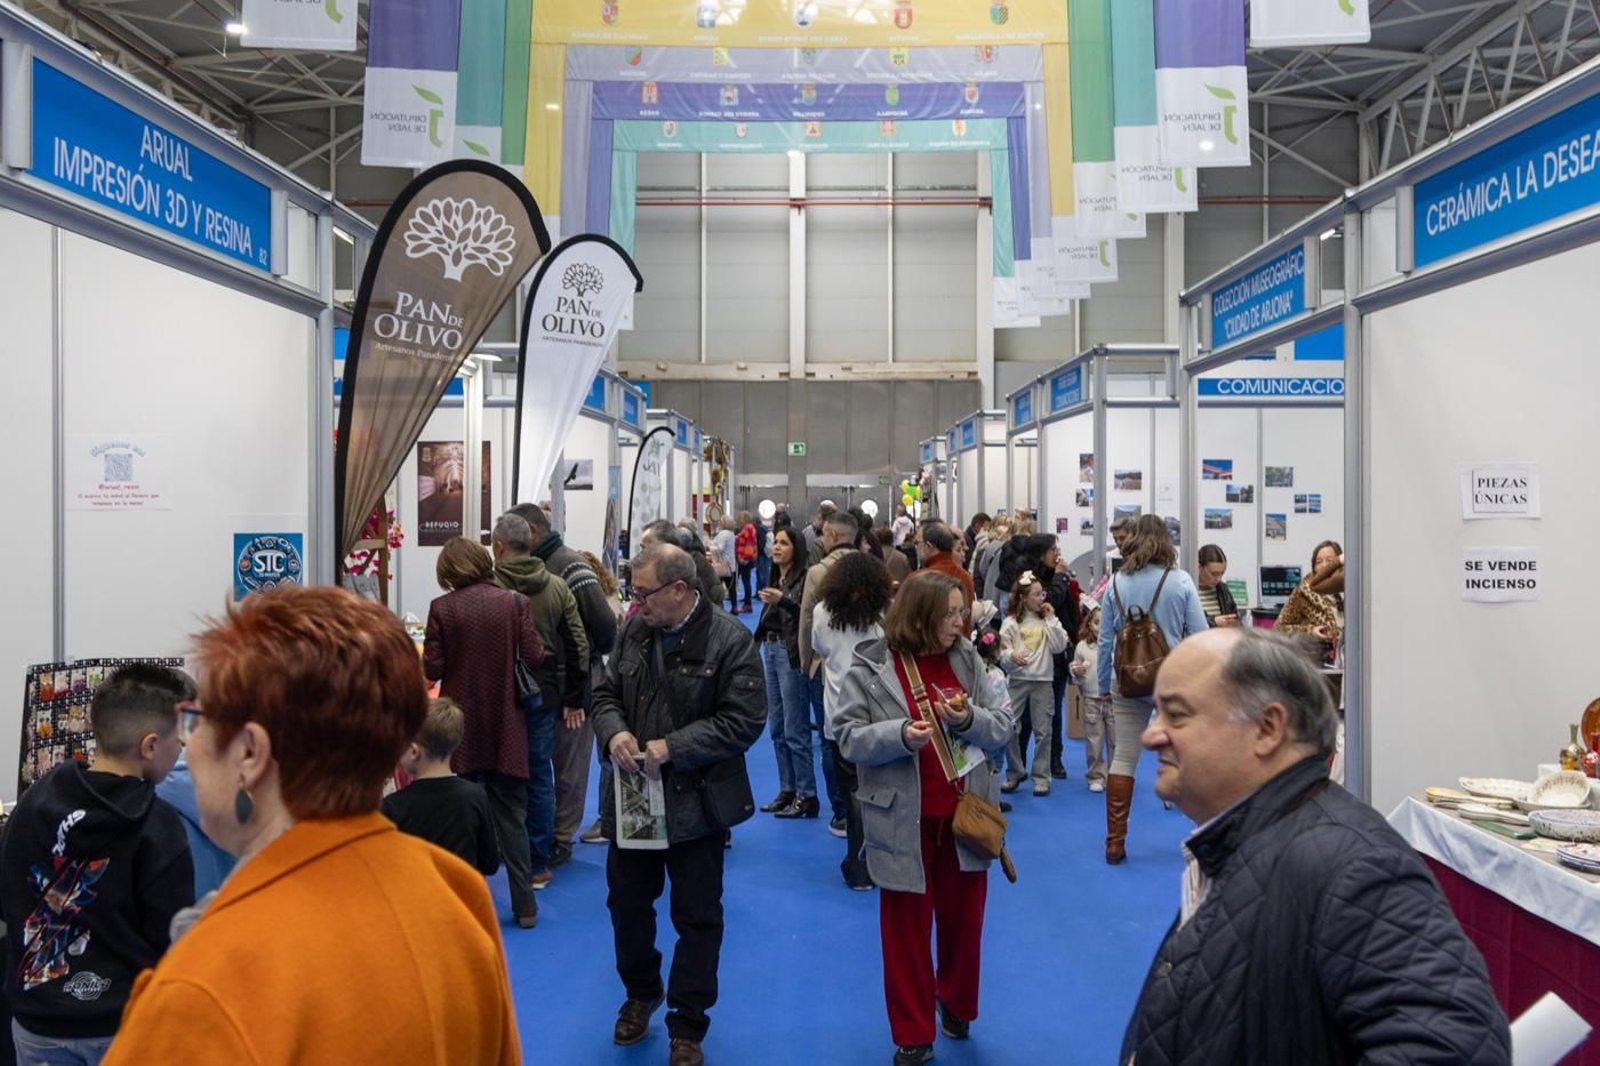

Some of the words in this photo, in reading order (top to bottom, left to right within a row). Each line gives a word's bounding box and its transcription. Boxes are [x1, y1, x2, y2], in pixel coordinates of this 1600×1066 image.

[140, 124, 193, 183] ARUAL
[54, 136, 160, 219] IMPRESIÓN
[165, 188, 188, 229] 3D
[192, 200, 203, 235] Y
[205, 207, 253, 258] RESINA
[1426, 172, 1512, 237] CERÁMICA
[1516, 160, 1539, 200] LA
[1214, 275, 1251, 317] COLECCIÓN
[1251, 249, 1304, 297] MUSEOGRÁFIC
[394, 290, 452, 324] PAN
[448, 314, 465, 328] DE
[555, 295, 592, 316] PAN
[1250, 304, 1260, 329] DE
[374, 313, 463, 350] OLIVO
[542, 313, 605, 339] OLIVO
[375, 342, 415, 356] Artesanos
[1477, 477, 1527, 489] PIEZAS
[1475, 490, 1527, 505] ÚNICAS
[254, 552, 285, 573] STC
[1464, 560, 1484, 571] SE
[1488, 560, 1537, 571] VENDE
[1465, 578, 1537, 589] INCIENSO
